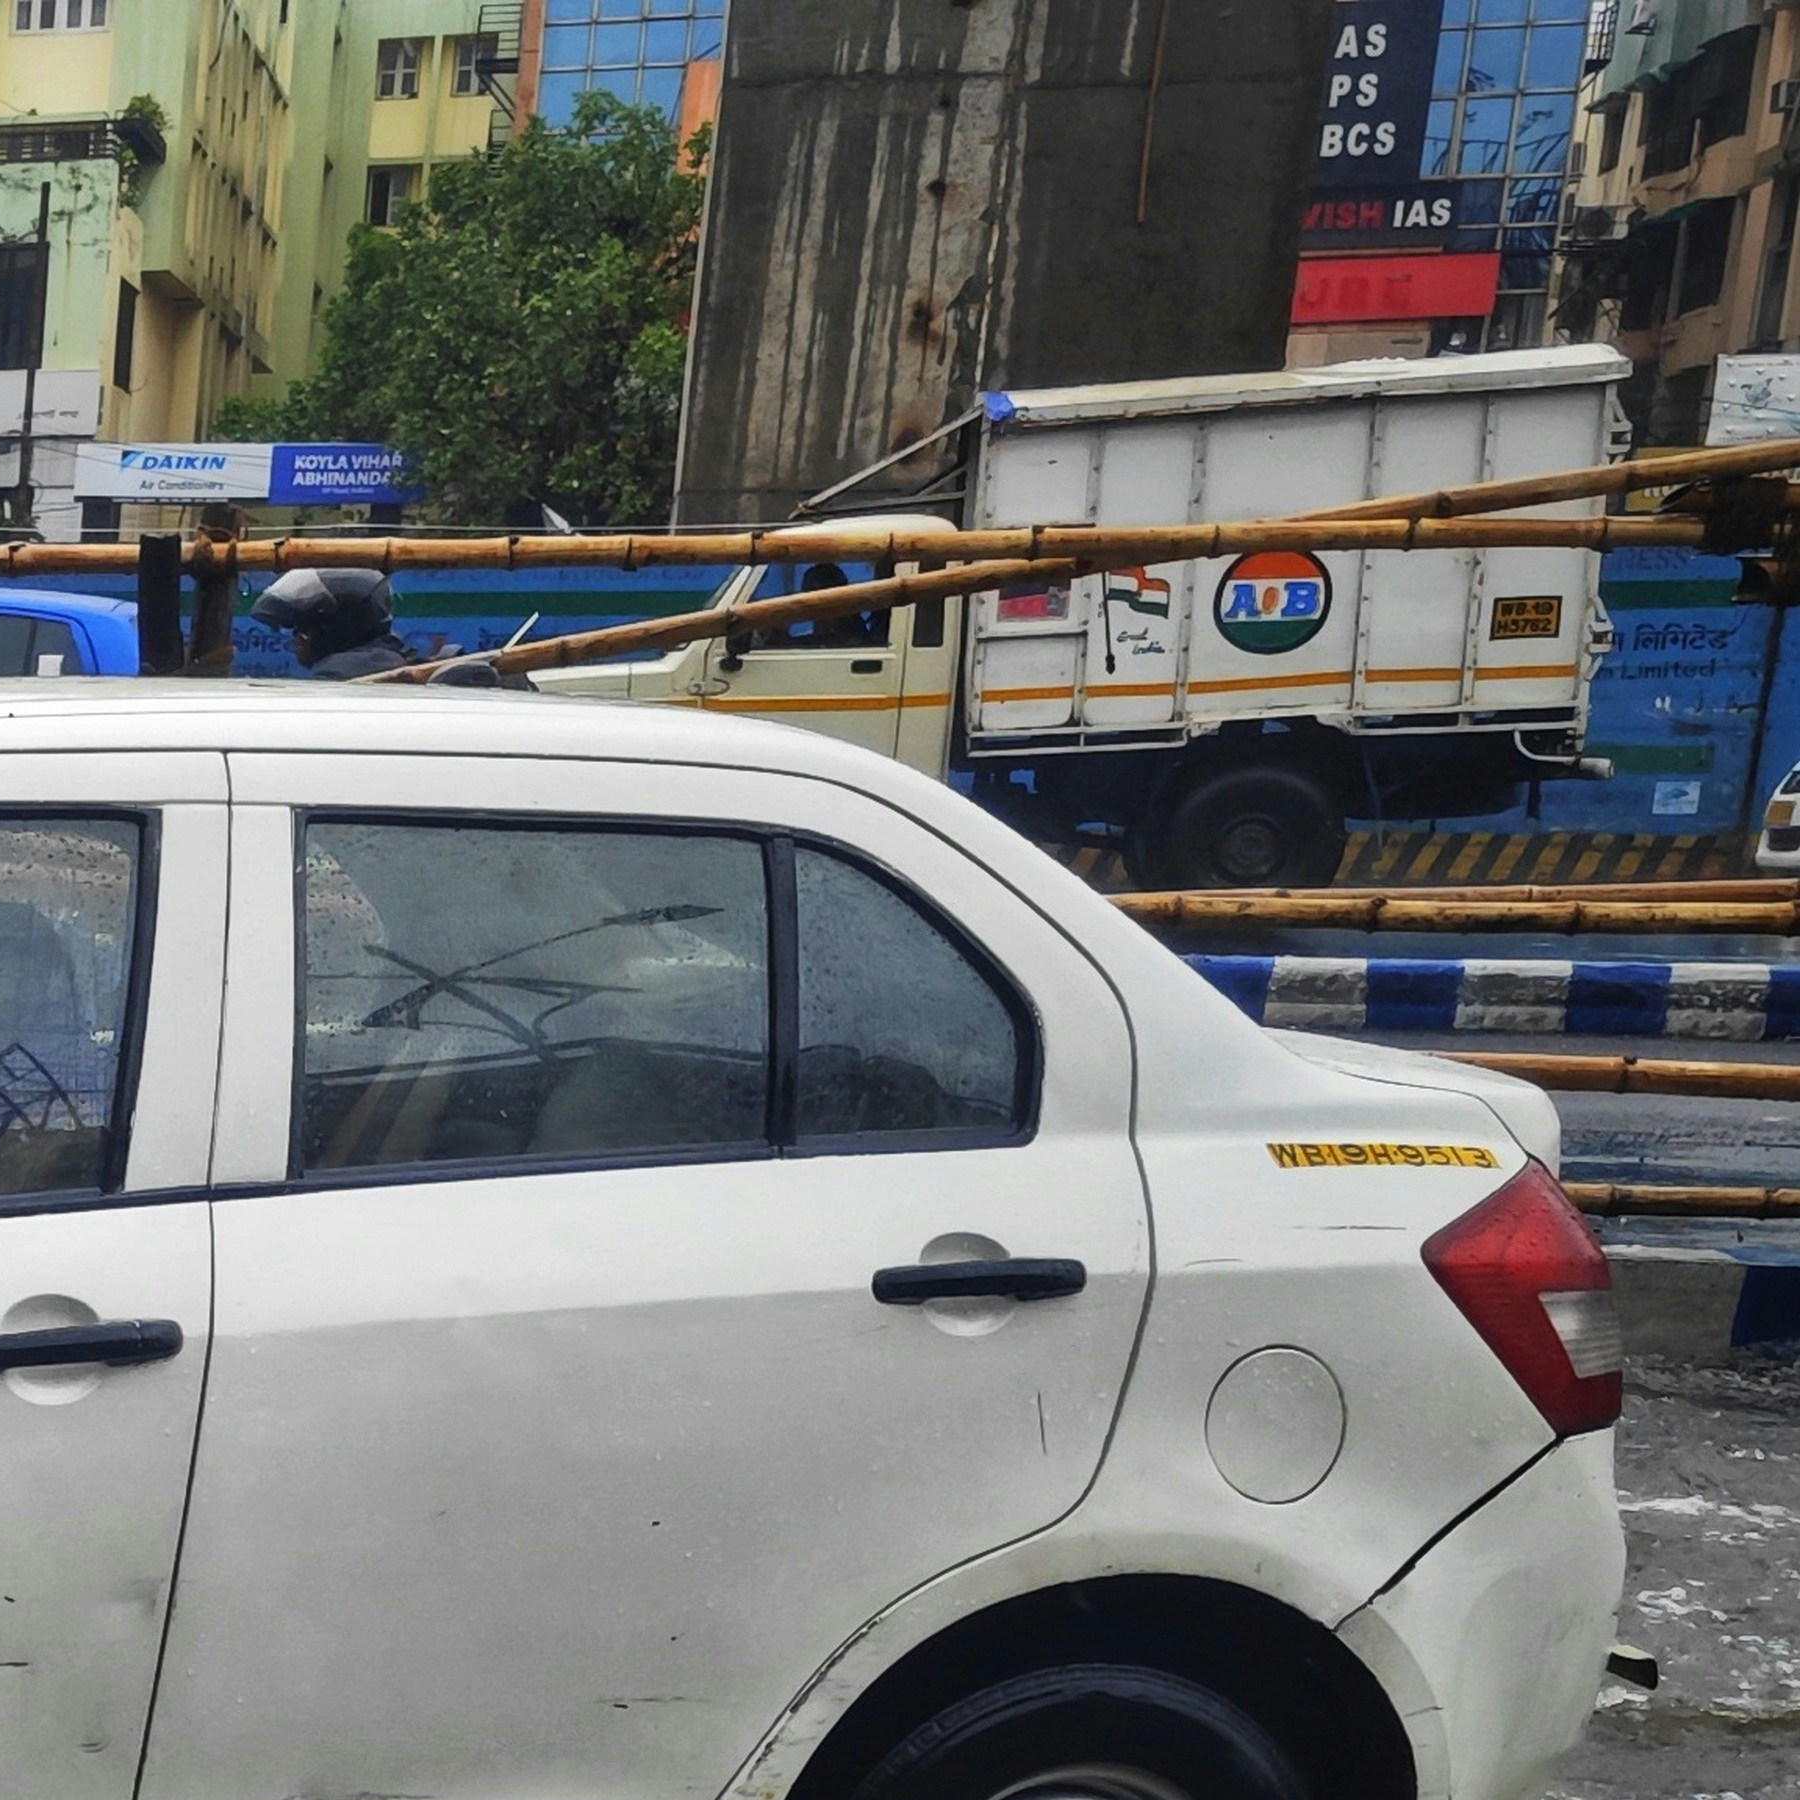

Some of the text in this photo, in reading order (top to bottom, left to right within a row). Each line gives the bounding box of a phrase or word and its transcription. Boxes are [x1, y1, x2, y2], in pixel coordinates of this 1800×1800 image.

[1328, 73, 1379, 108] PS
[1318, 121, 1396, 157] BCS
[1393, 198, 1452, 228] IAS
[140, 454, 227, 471] DAIKIN
[294, 453, 403, 470] KOYLA VIHAR
[139, 480, 224, 491] Air Conditioners
[1620, 658, 1716, 681] Limited
